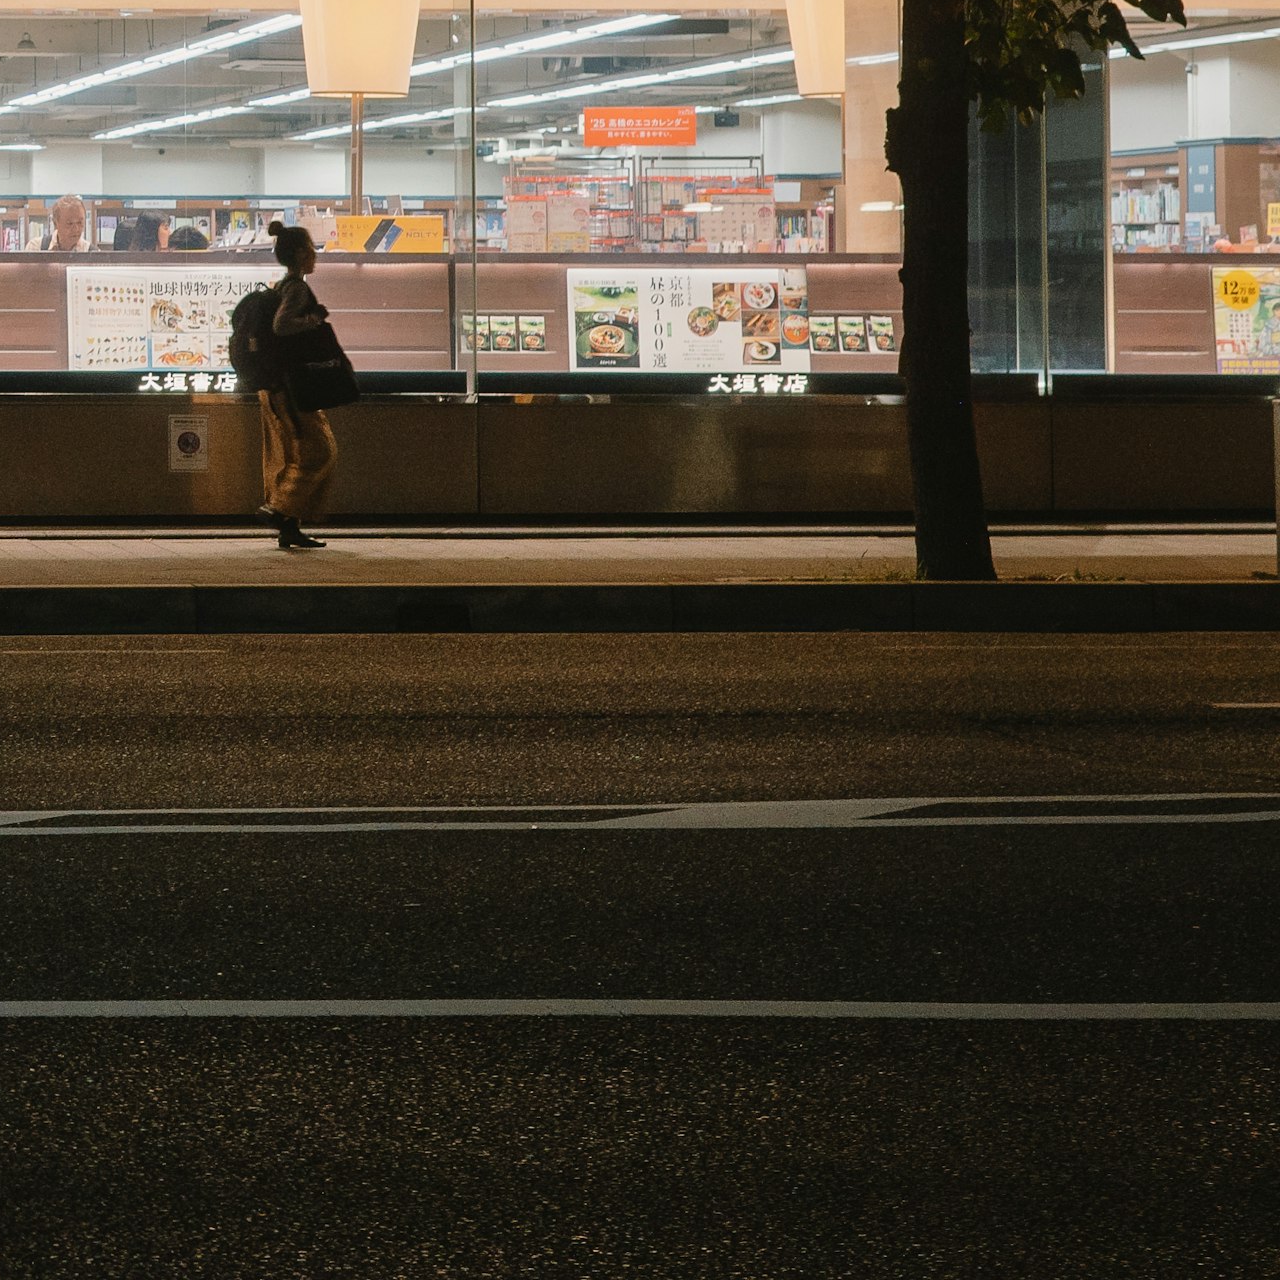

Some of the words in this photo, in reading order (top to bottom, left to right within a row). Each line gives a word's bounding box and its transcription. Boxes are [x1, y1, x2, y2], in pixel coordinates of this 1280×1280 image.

[669, 276, 684, 308] 京都
[138, 372, 238, 393] 大垣書店
[707, 373, 808, 394] 大垣書店
